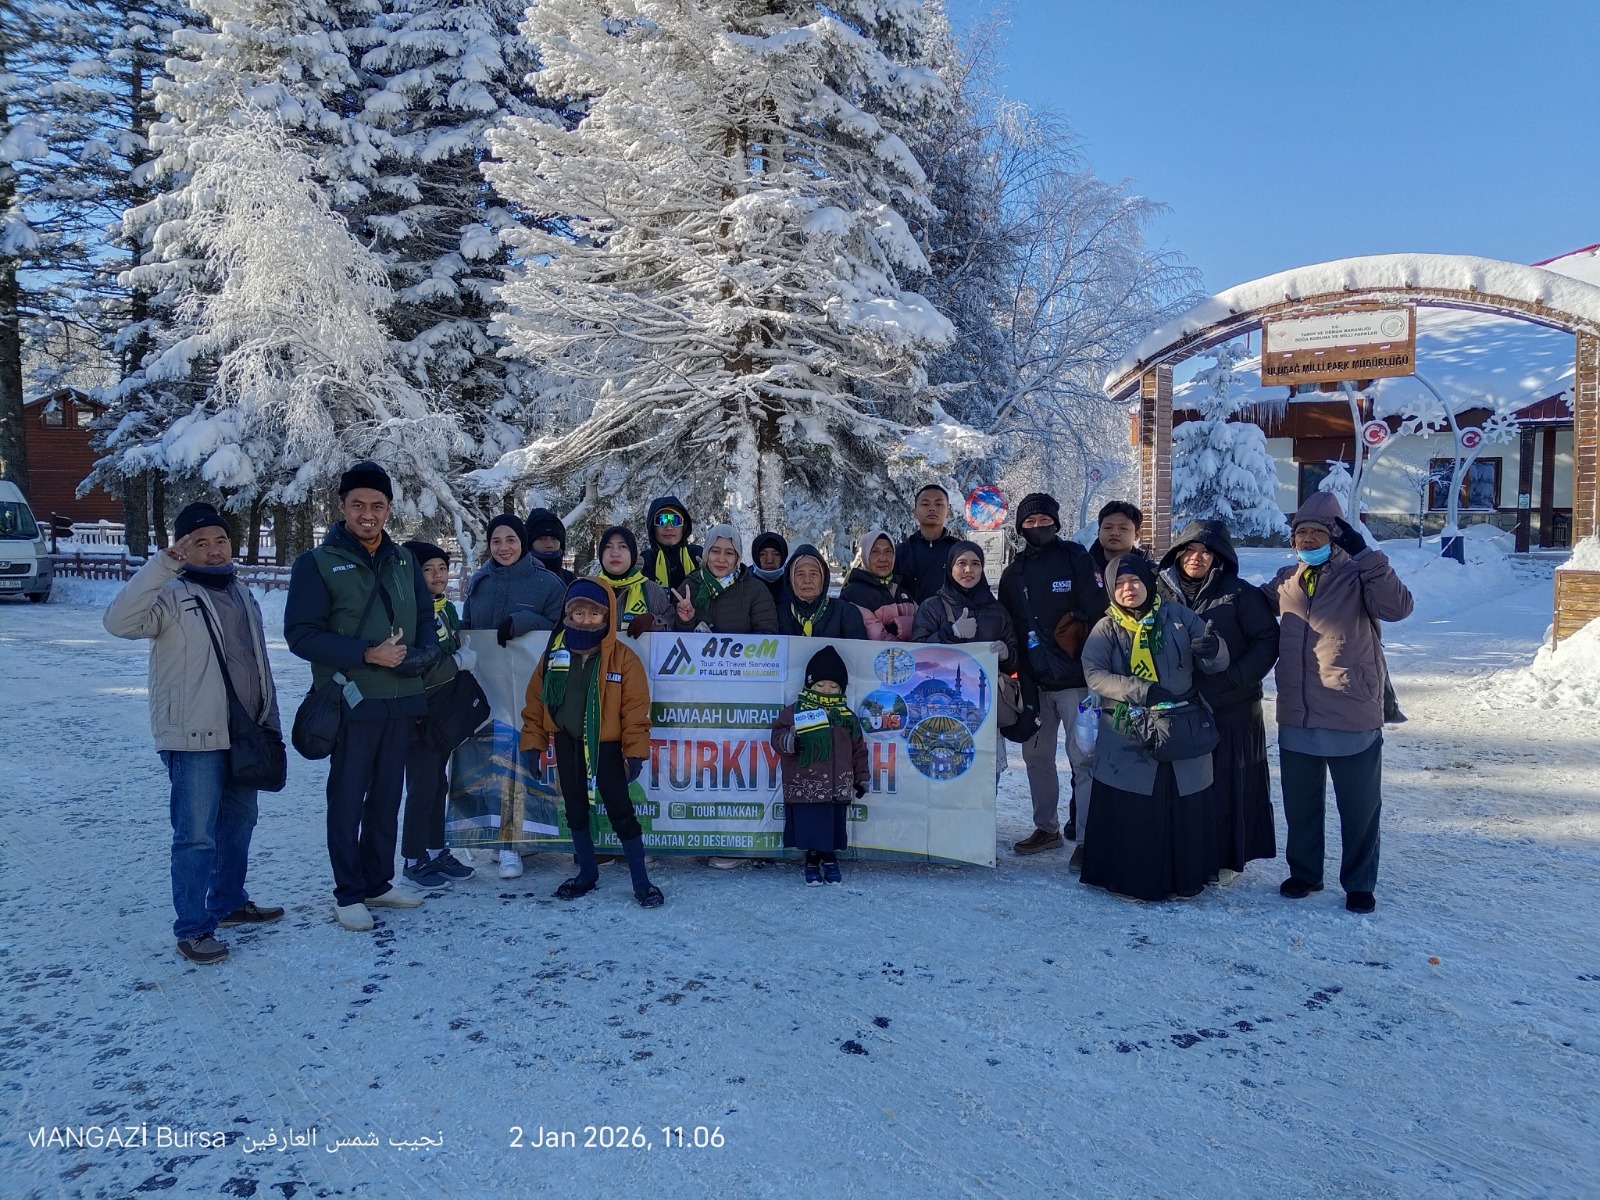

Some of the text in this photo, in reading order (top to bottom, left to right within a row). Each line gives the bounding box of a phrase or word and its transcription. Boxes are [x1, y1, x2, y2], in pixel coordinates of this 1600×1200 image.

[1267, 355, 1409, 376] ULUDAĞ MİLLİ PARK MÜDÜRLÜĞÜ
[748, 661, 780, 669] Services
[708, 669, 728, 677] ALLAIS
[657, 707, 722, 723] JAMAAH
[726, 708, 780, 724] UMRAH
[649, 738, 782, 791] TURKIY
[691, 805, 758, 818] TOUR MAKKAH
[688, 834, 700, 847] 29
[702, 835, 754, 848] DESEMBER
[763, 835, 775, 848] 11
